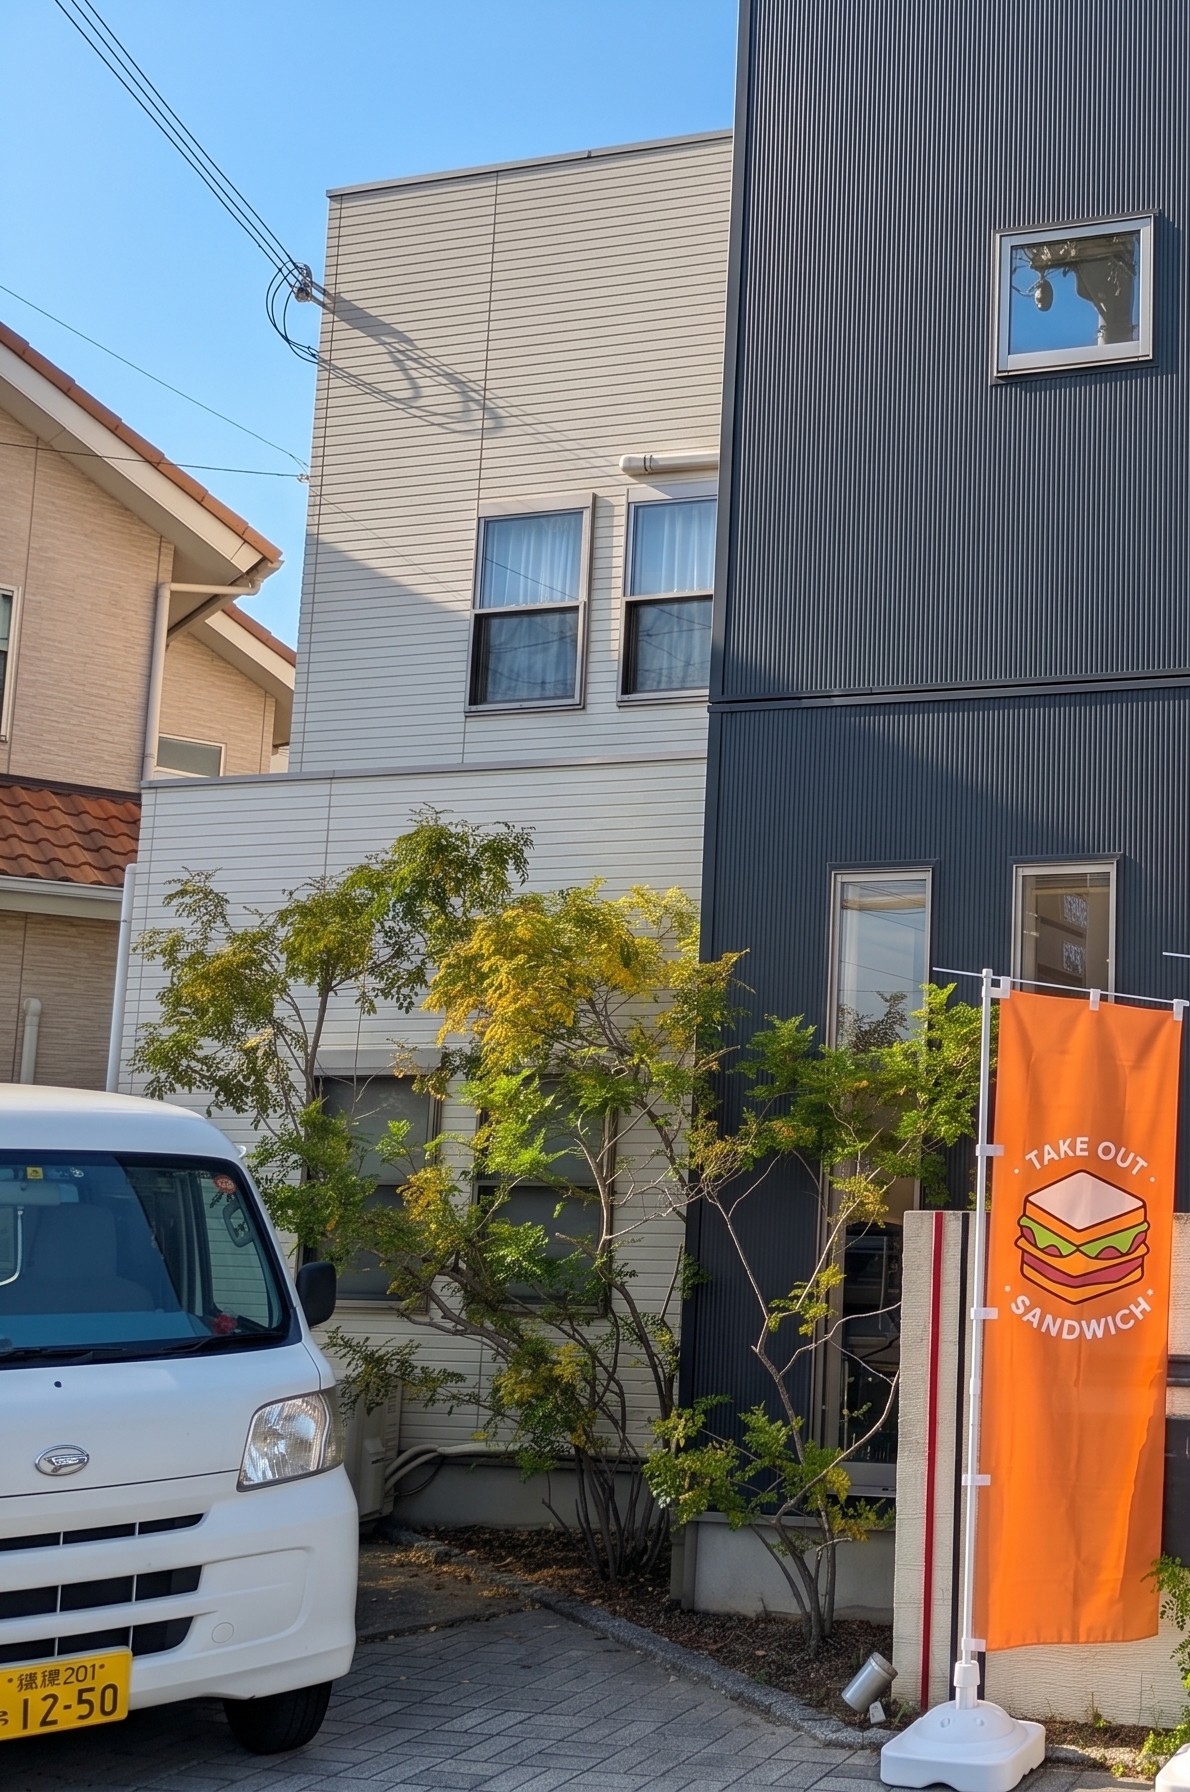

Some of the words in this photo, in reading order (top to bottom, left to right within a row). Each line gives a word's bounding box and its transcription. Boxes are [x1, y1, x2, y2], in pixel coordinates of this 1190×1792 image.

[1025, 1136, 1089, 1170] TAKE
[1097, 1141, 1148, 1175] OUT
[1010, 1294, 1151, 1340] SANDWICH
[22, 1683, 118, 1731] 12-50
